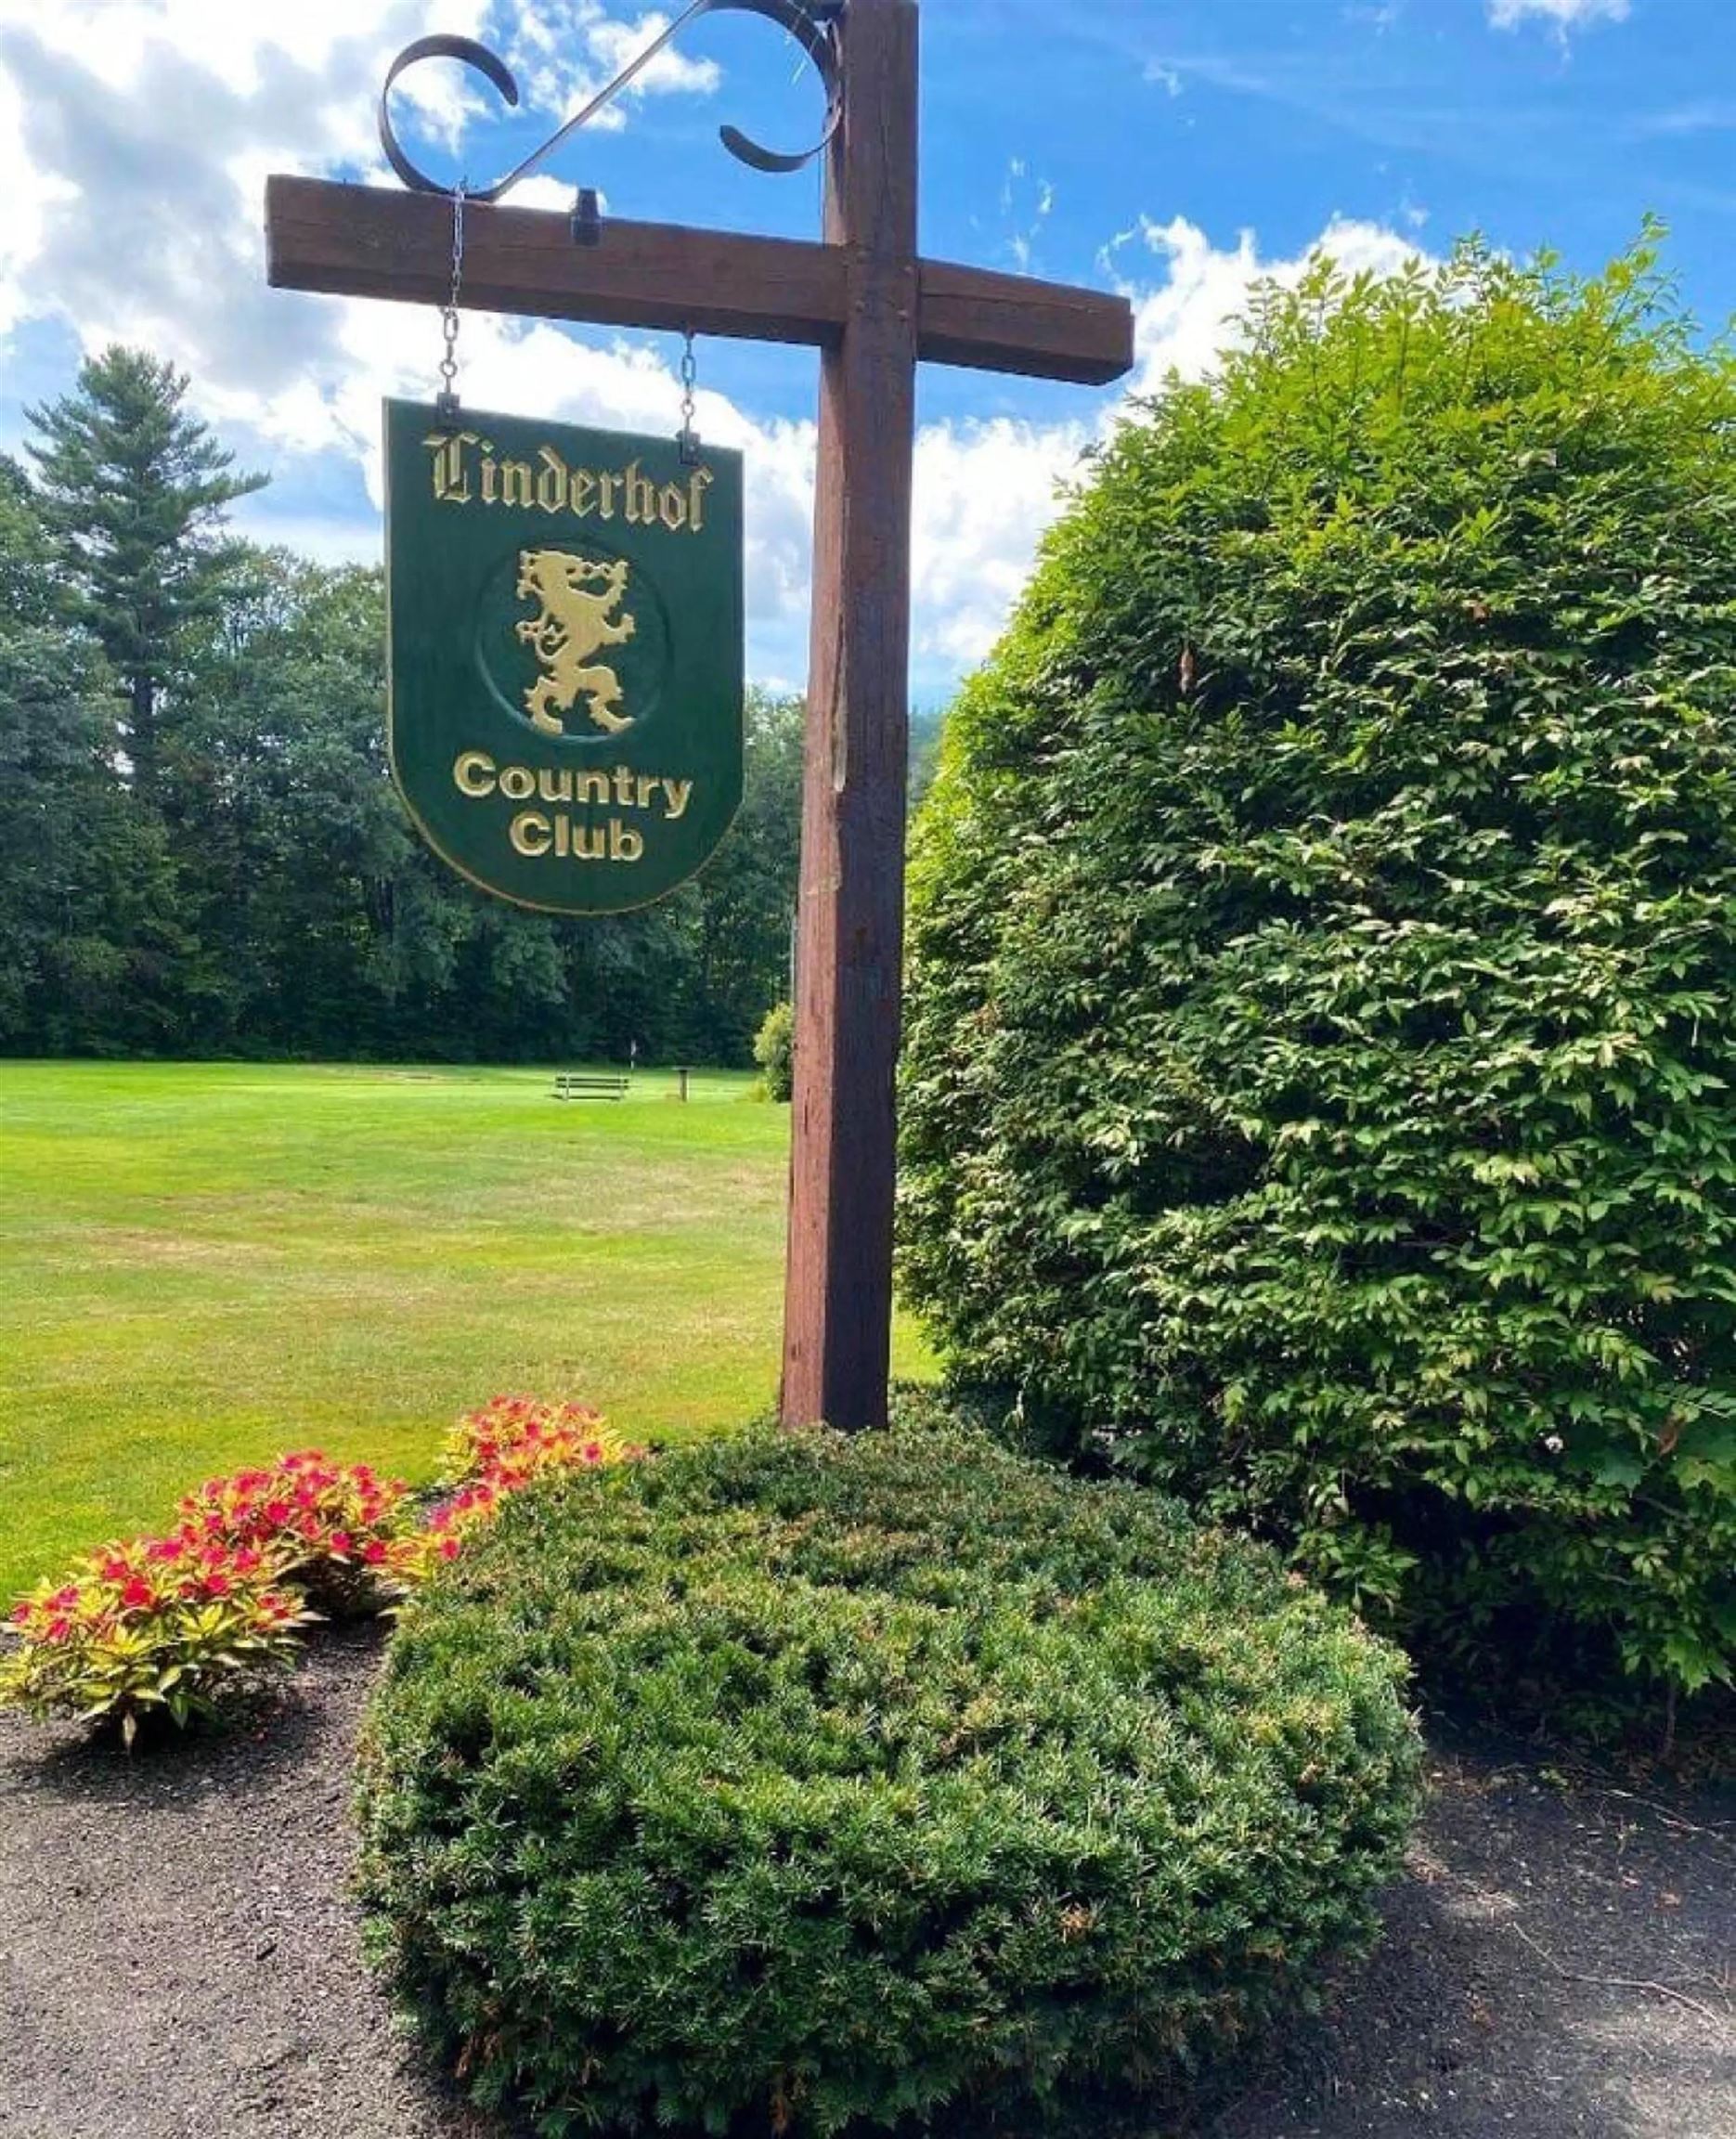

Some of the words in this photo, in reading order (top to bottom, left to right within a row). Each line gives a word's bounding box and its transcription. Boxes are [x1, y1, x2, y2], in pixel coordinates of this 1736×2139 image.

[422, 432, 714, 533] Linderhof
[452, 749, 693, 820] Country
[509, 810, 644, 862] Club
